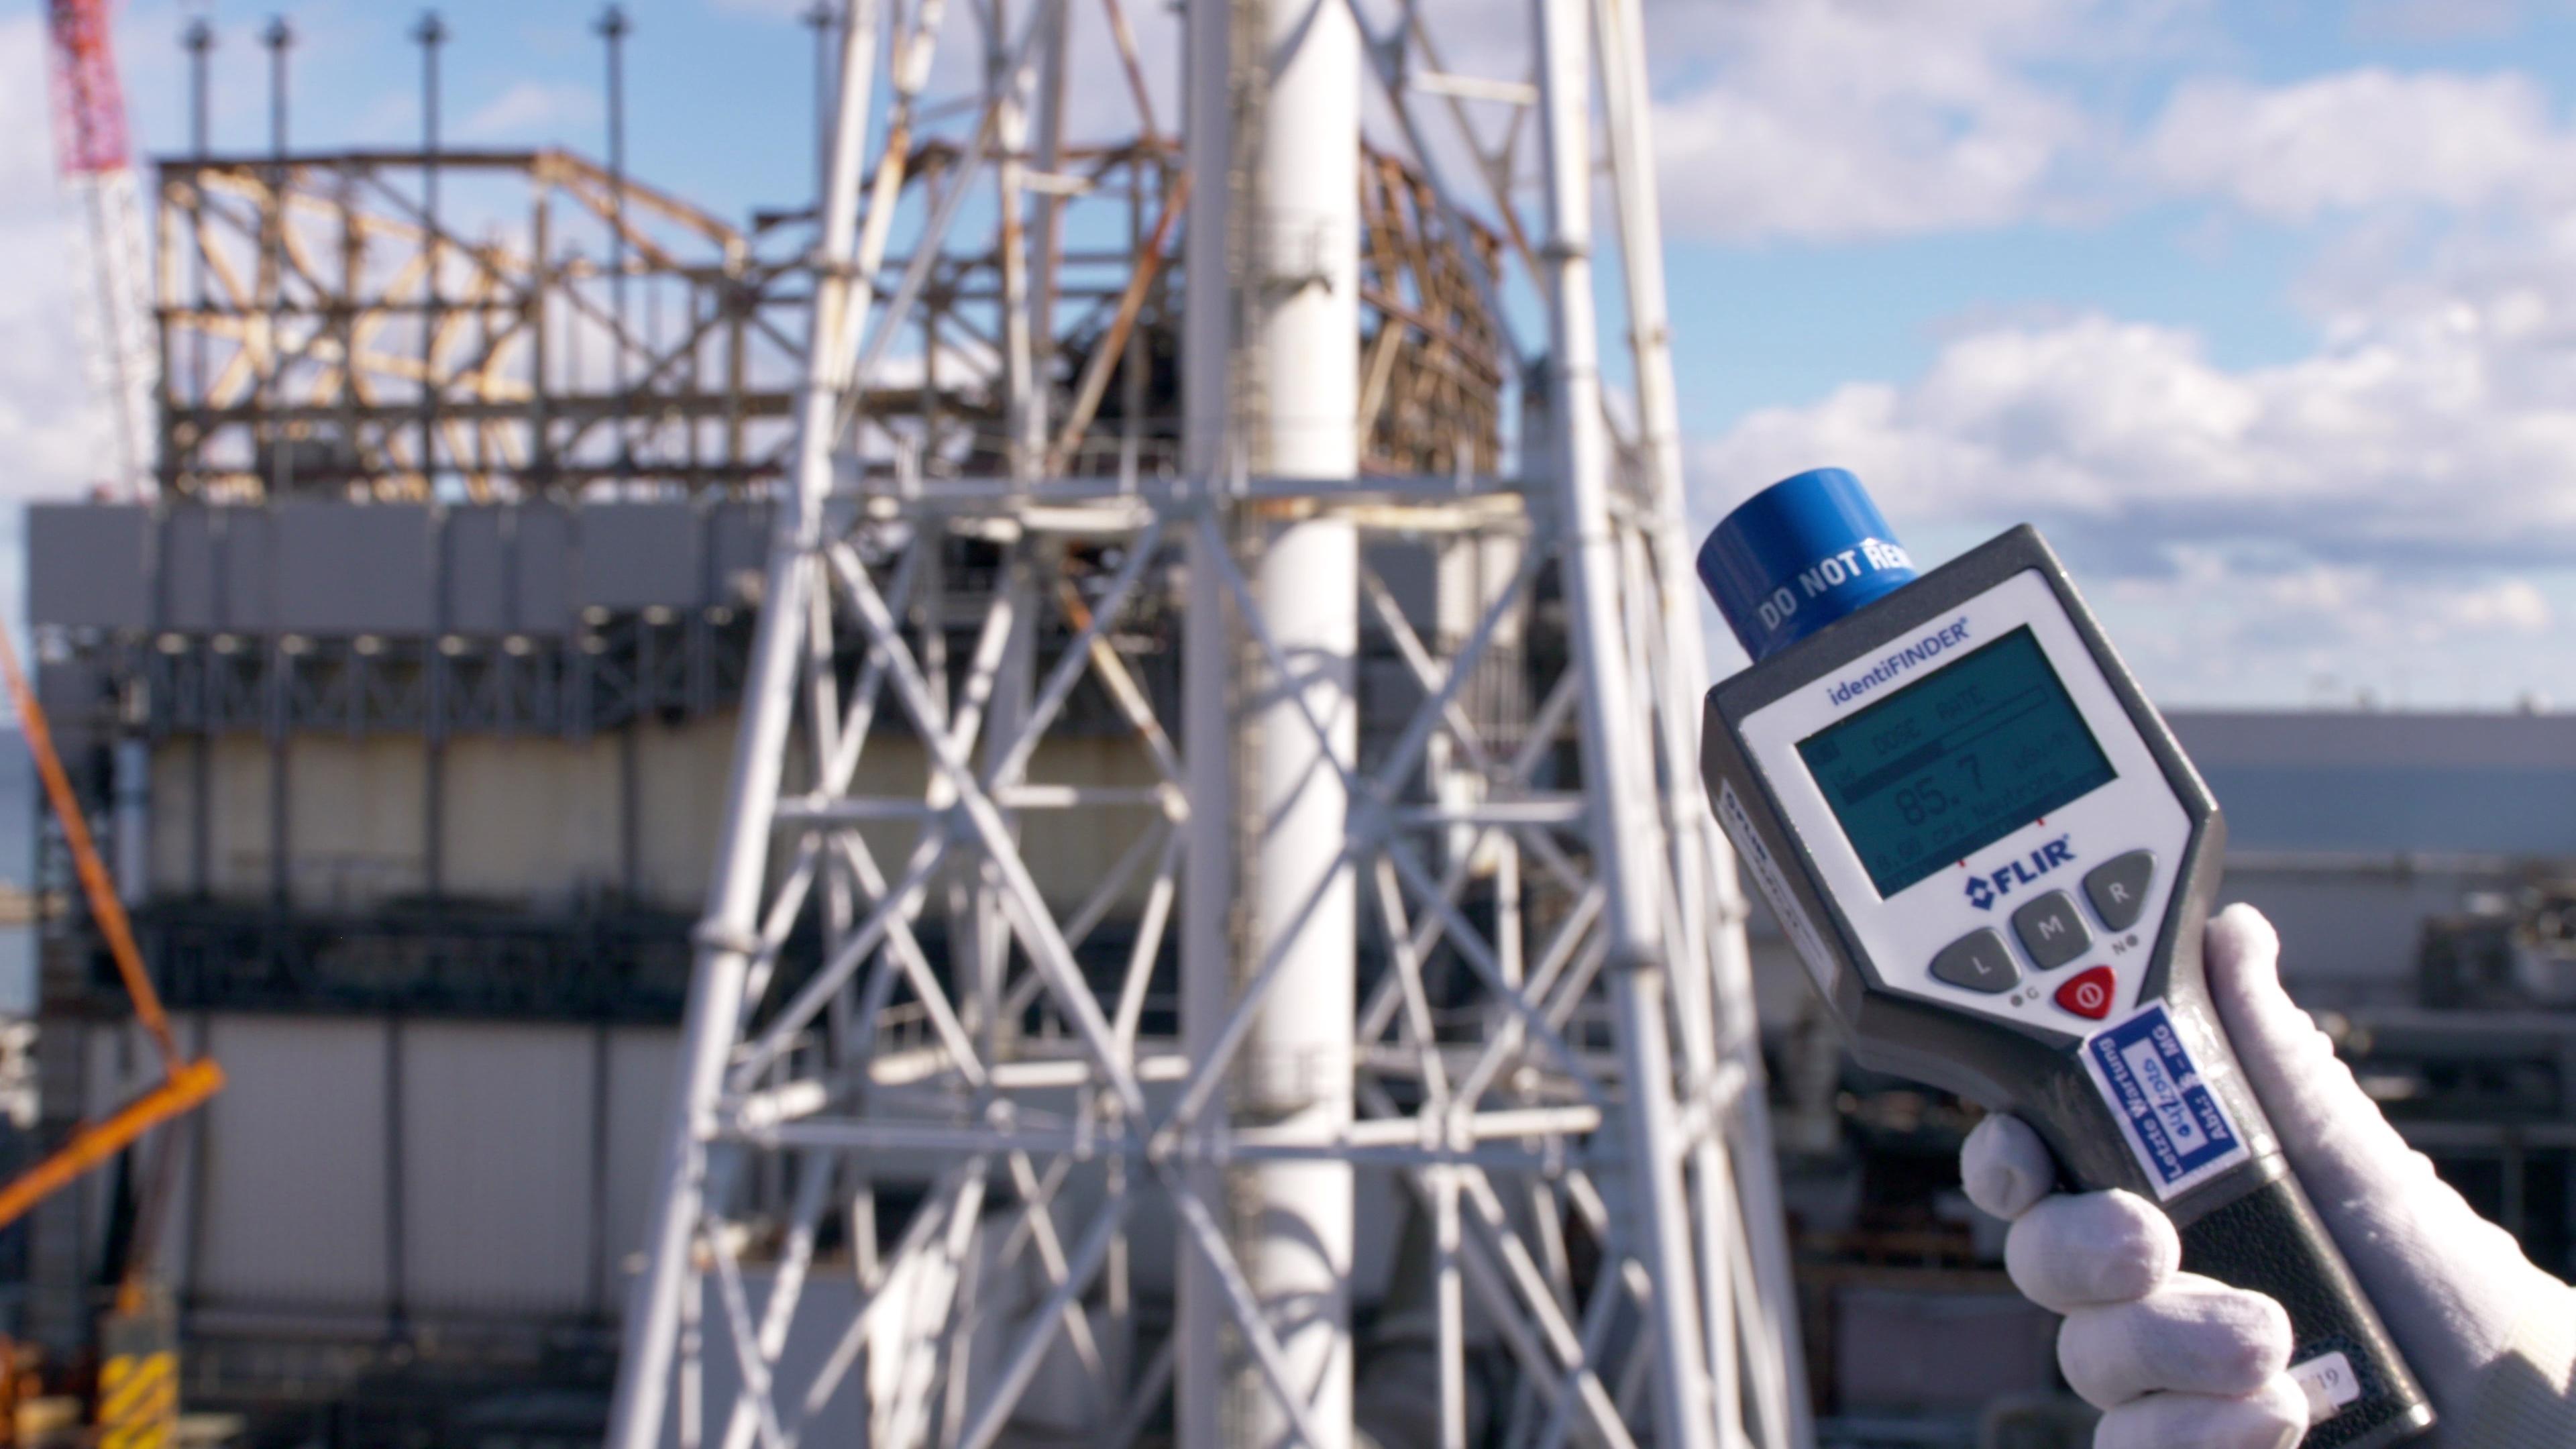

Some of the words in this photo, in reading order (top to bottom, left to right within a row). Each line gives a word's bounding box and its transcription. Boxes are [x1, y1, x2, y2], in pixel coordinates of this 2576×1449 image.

[1760, 587, 1796, 631] DO
[1799, 550, 1861, 597] NOT
[1935, 683, 1985, 722] RATE
[1894, 753, 1988, 826] 85.7
[1992, 839, 2076, 894] FLIR
[2109, 883, 2129, 903] R
[2038, 916, 2064, 940] M
[1972, 956, 1991, 974] L
[2112, 941, 2127, 955] N
[2026, 986, 2039, 1000] G
[2149, 1022, 2180, 1057] MG
[2096, 1035, 2150, 1119] Wartung
[2139, 1116, 2185, 1181] Letzte
